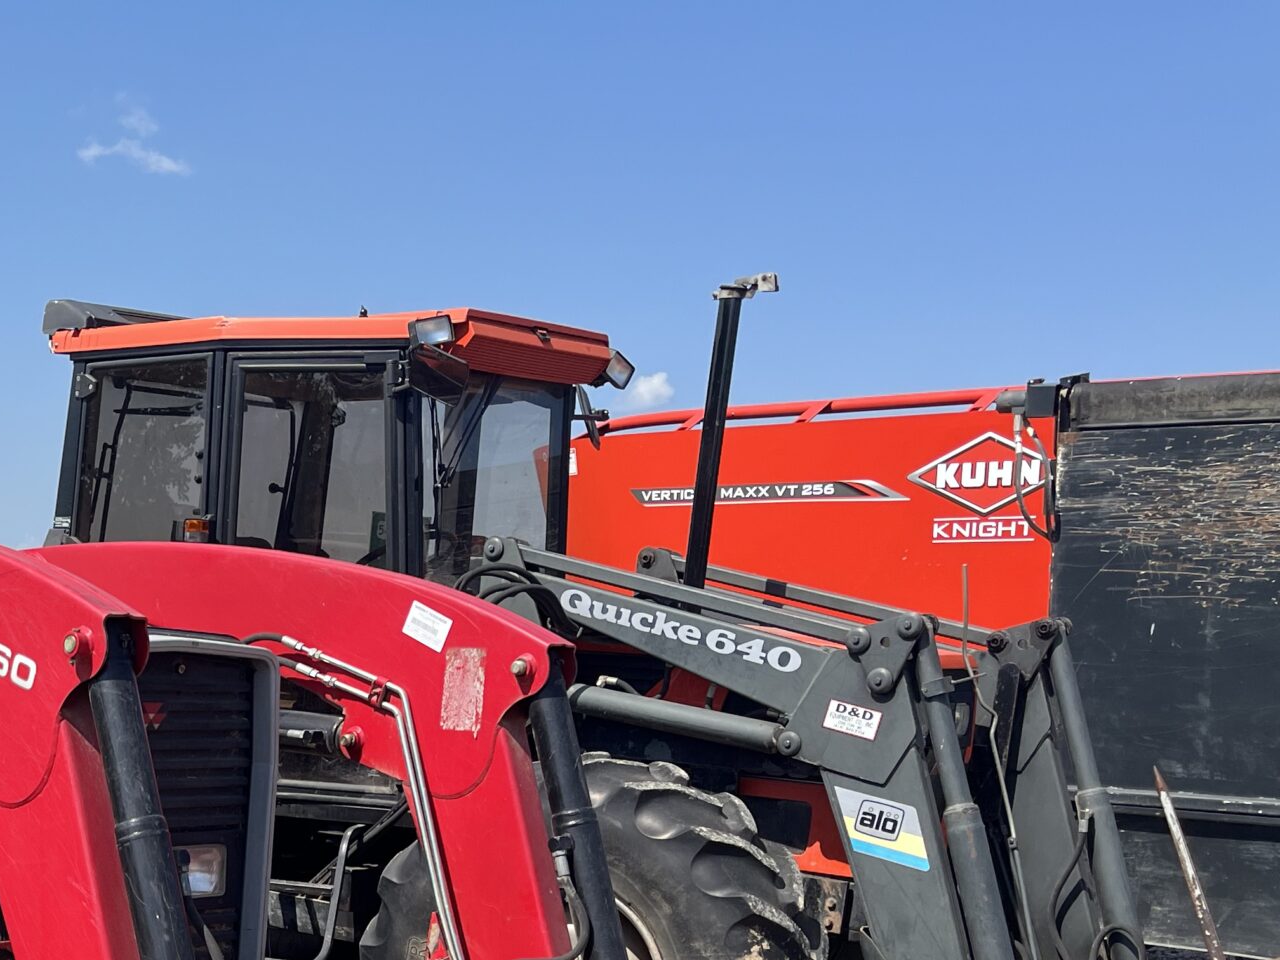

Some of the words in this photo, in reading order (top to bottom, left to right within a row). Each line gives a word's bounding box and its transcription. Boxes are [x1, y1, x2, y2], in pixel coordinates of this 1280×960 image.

[935, 459, 1041, 490] KUHN
[641, 489, 695, 502] VERTIC
[720, 485, 771, 500] MAXX
[775, 485, 800, 498] VT
[801, 483, 836, 497] 256
[932, 520, 1035, 539] KNIGHT
[560, 588, 702, 647] Quicke
[705, 628, 802, 673] 640
